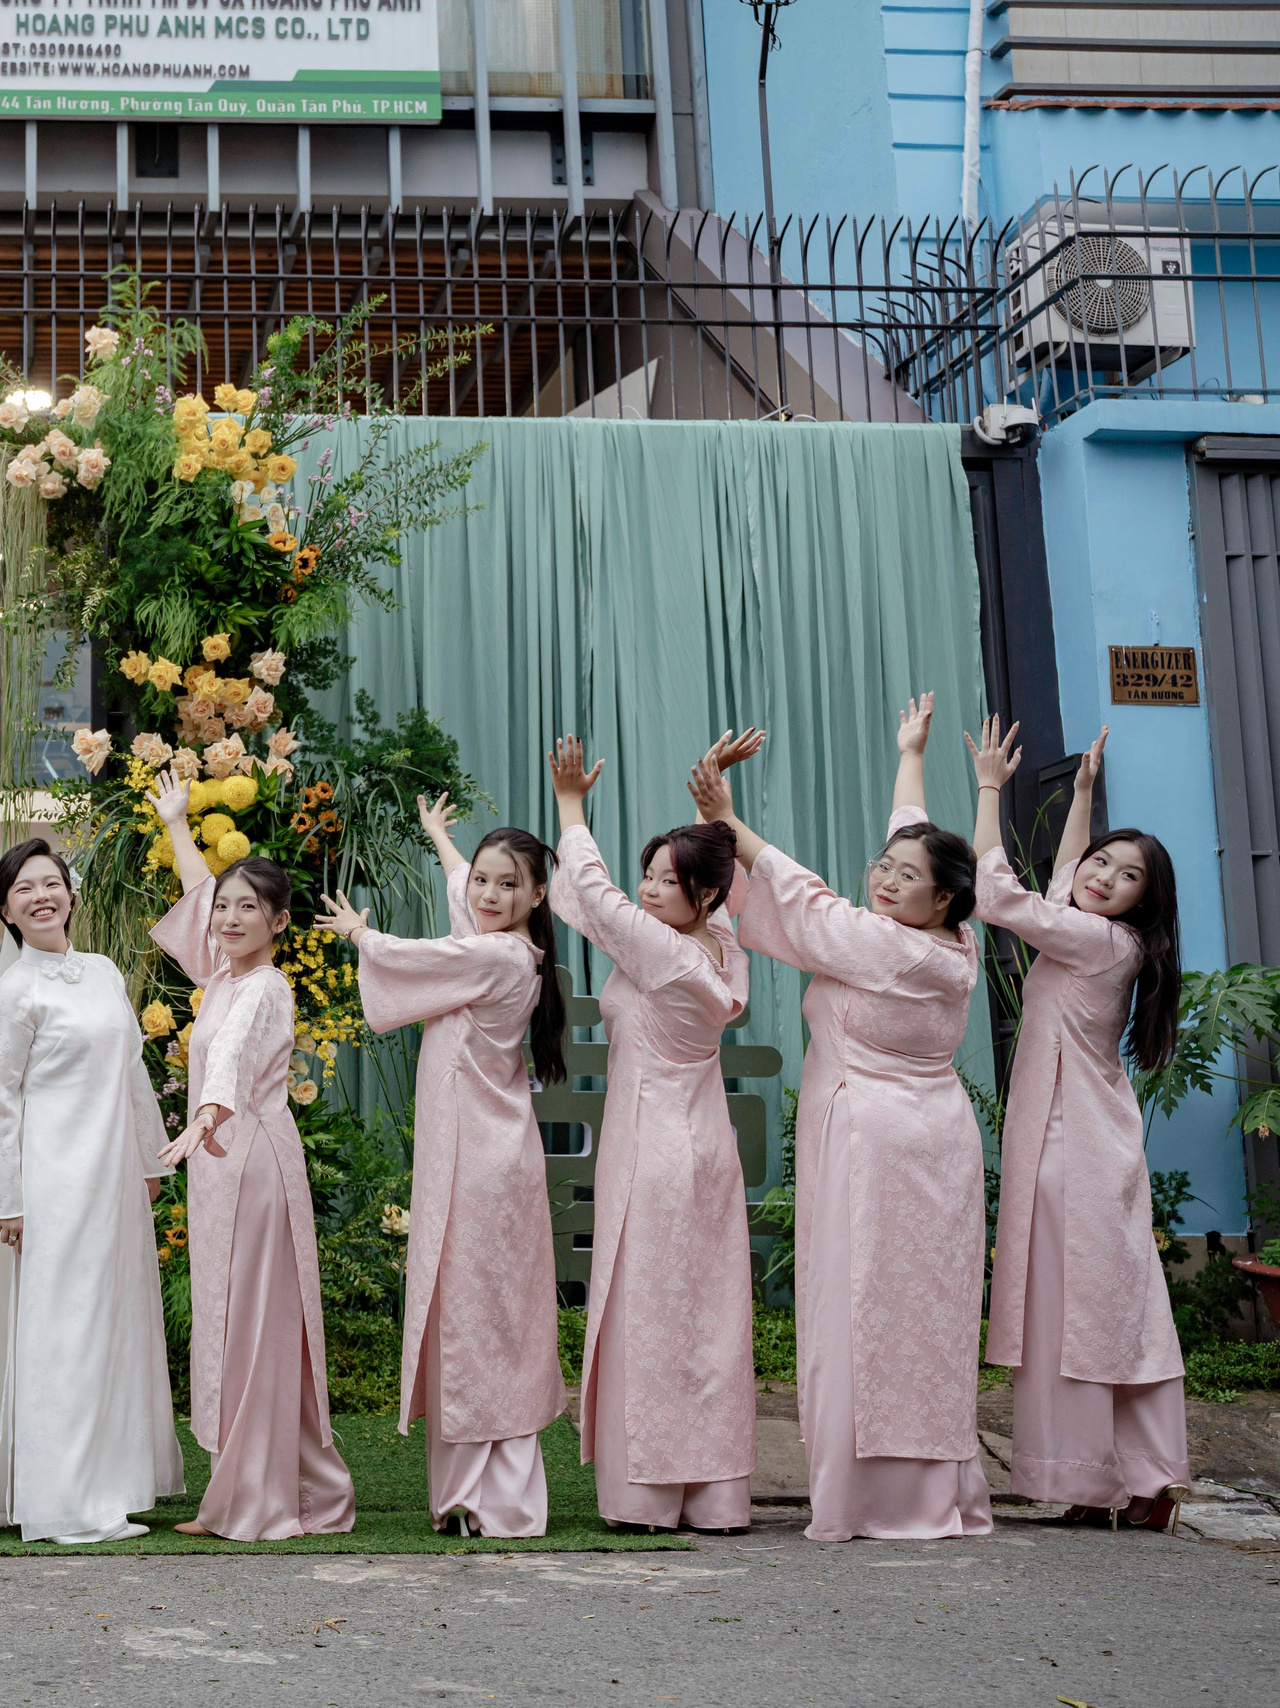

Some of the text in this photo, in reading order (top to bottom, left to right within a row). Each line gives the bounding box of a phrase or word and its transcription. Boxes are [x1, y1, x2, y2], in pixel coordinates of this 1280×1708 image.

[15, 13, 95, 38] HOANG
[104, 14, 149, 38] PHU
[156, 15, 206, 39] ANH
[214, 16, 266, 39] MCS
[327, 17, 371, 41] LTD
[372, 99, 428, 115] TP.HCM
[1115, 651, 1191, 670] ENERGIZER
[1116, 674, 1192, 687] 329/42
